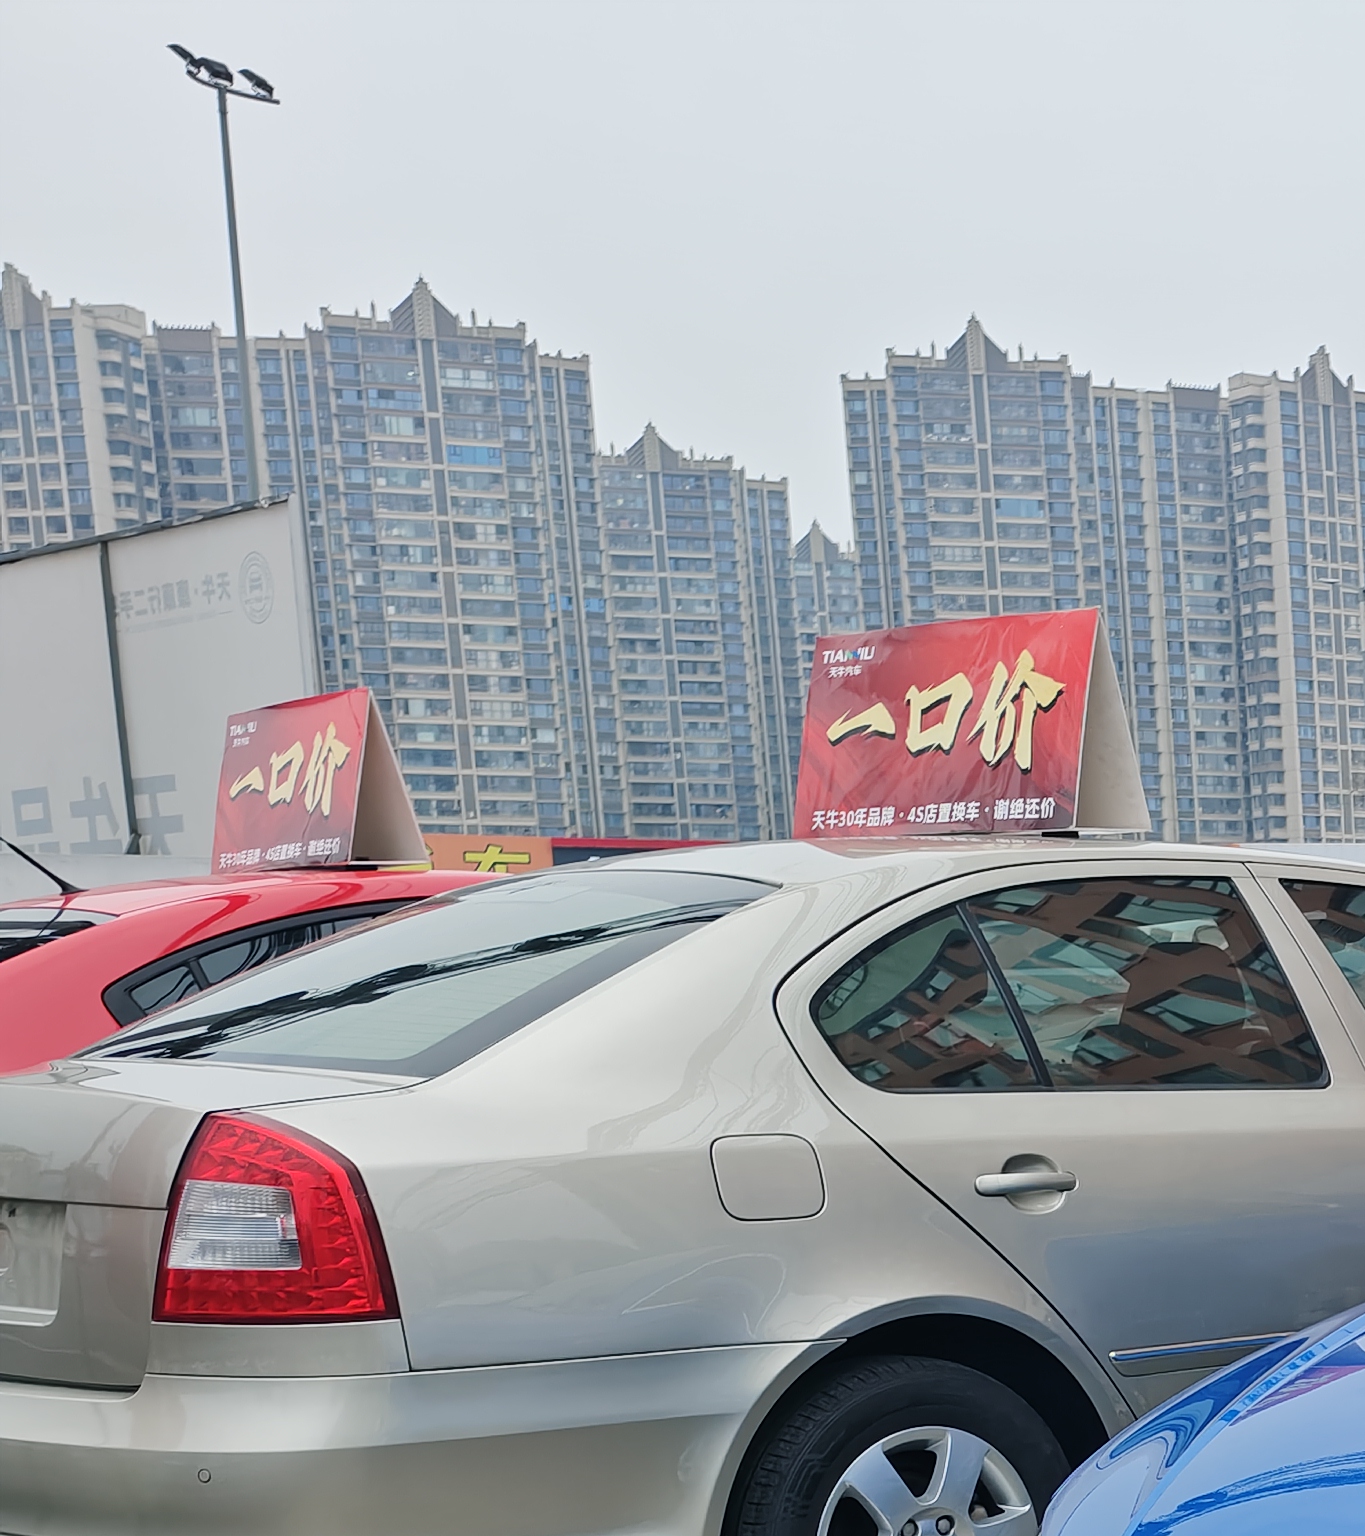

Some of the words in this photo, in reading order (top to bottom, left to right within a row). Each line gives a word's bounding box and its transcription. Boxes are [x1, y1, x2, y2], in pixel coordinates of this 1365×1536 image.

[827, 649, 1066, 775] 一口价
[229, 722, 351, 819] 一口价
